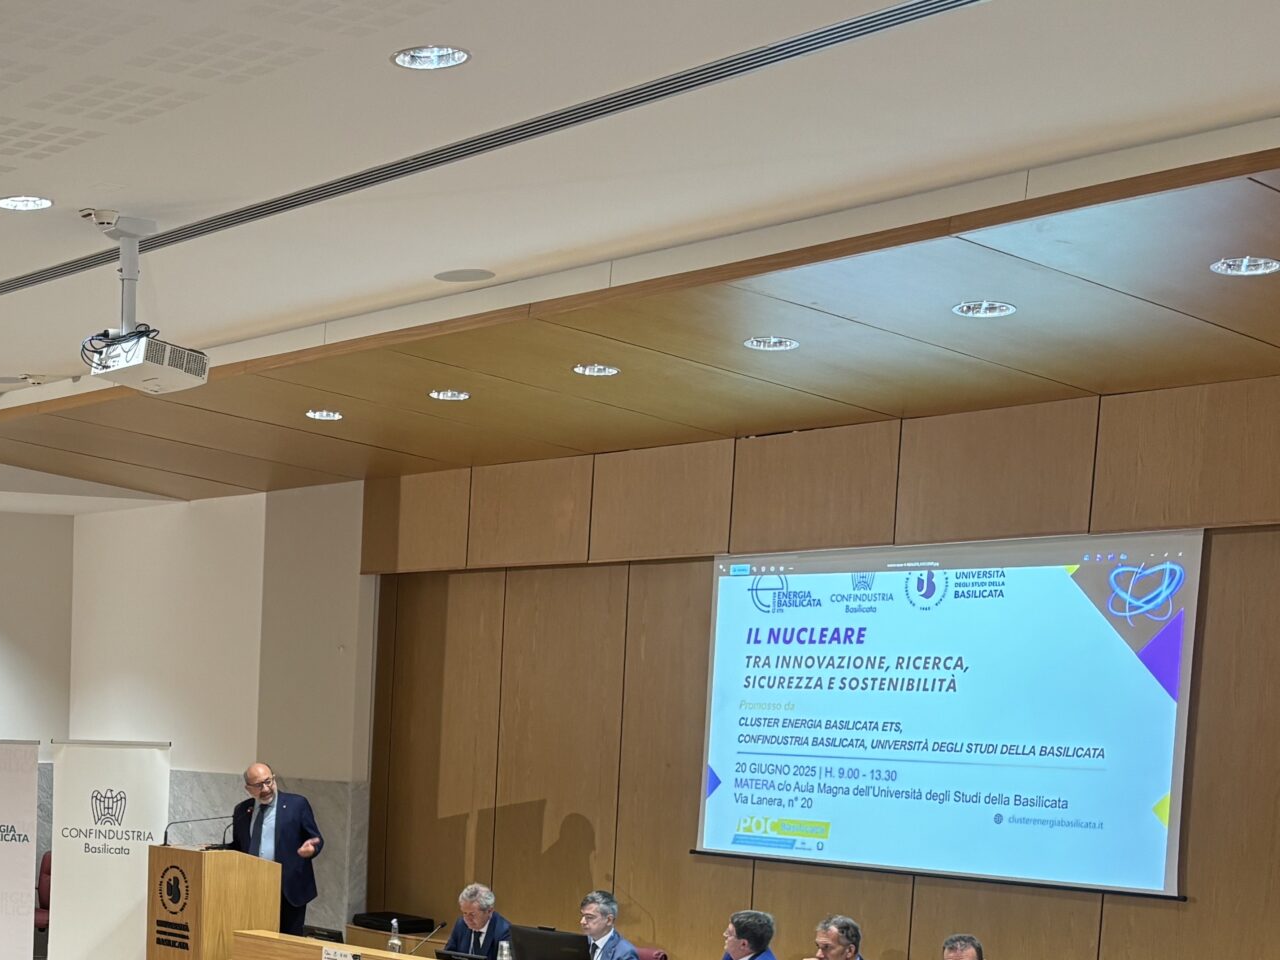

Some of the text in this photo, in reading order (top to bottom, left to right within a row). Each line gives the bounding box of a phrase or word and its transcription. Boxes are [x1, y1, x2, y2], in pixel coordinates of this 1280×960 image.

[777, 590, 812, 600] ENERGIA
[830, 593, 894, 603] CONFINDUSTRIA
[954, 589, 1005, 599] BASILICATA
[777, 599, 822, 608] BASILICATA
[845, 604, 877, 613] Basilicata
[746, 627, 867, 645] IL NUCLEARE
[745, 655, 970, 673] TRA INNOVAZIONE, RICERCA,
[743, 674, 957, 693] SICUREZZA E SOSTENIBILITÀ
[738, 716, 903, 734] CLUSTER ENERGIA BASILICATA ETS,
[738, 734, 1105, 759] CONFINDUSTRIA BASILICATA, UNIVERSITÀ DEGLI STUDI DELLA BASILICATA
[735, 762, 747, 774] 20
[749, 762, 791, 776] GIUGNO
[793, 765, 817, 777] 2025
[824, 767, 836, 778] H.
[838, 767, 860, 779] 9.00
[870, 769, 897, 782] 13.30
[734, 778, 776, 790] MATERA
[777, 780, 792, 792] c/o
[793, 781, 815, 793] Aula
[817, 782, 850, 797] Magna
[925, 789, 951, 804] degli
[953, 790, 981, 804] Studi
[983, 792, 1010, 806] della
[1013, 794, 1069, 810] Basilicata
[734, 793, 749, 805] Via
[750, 794, 786, 808] Lanera,
[800, 797, 813, 809] 20
[61, 827, 154, 841] CONFINDUSTRIA
[84, 842, 130, 855] Basilicata
